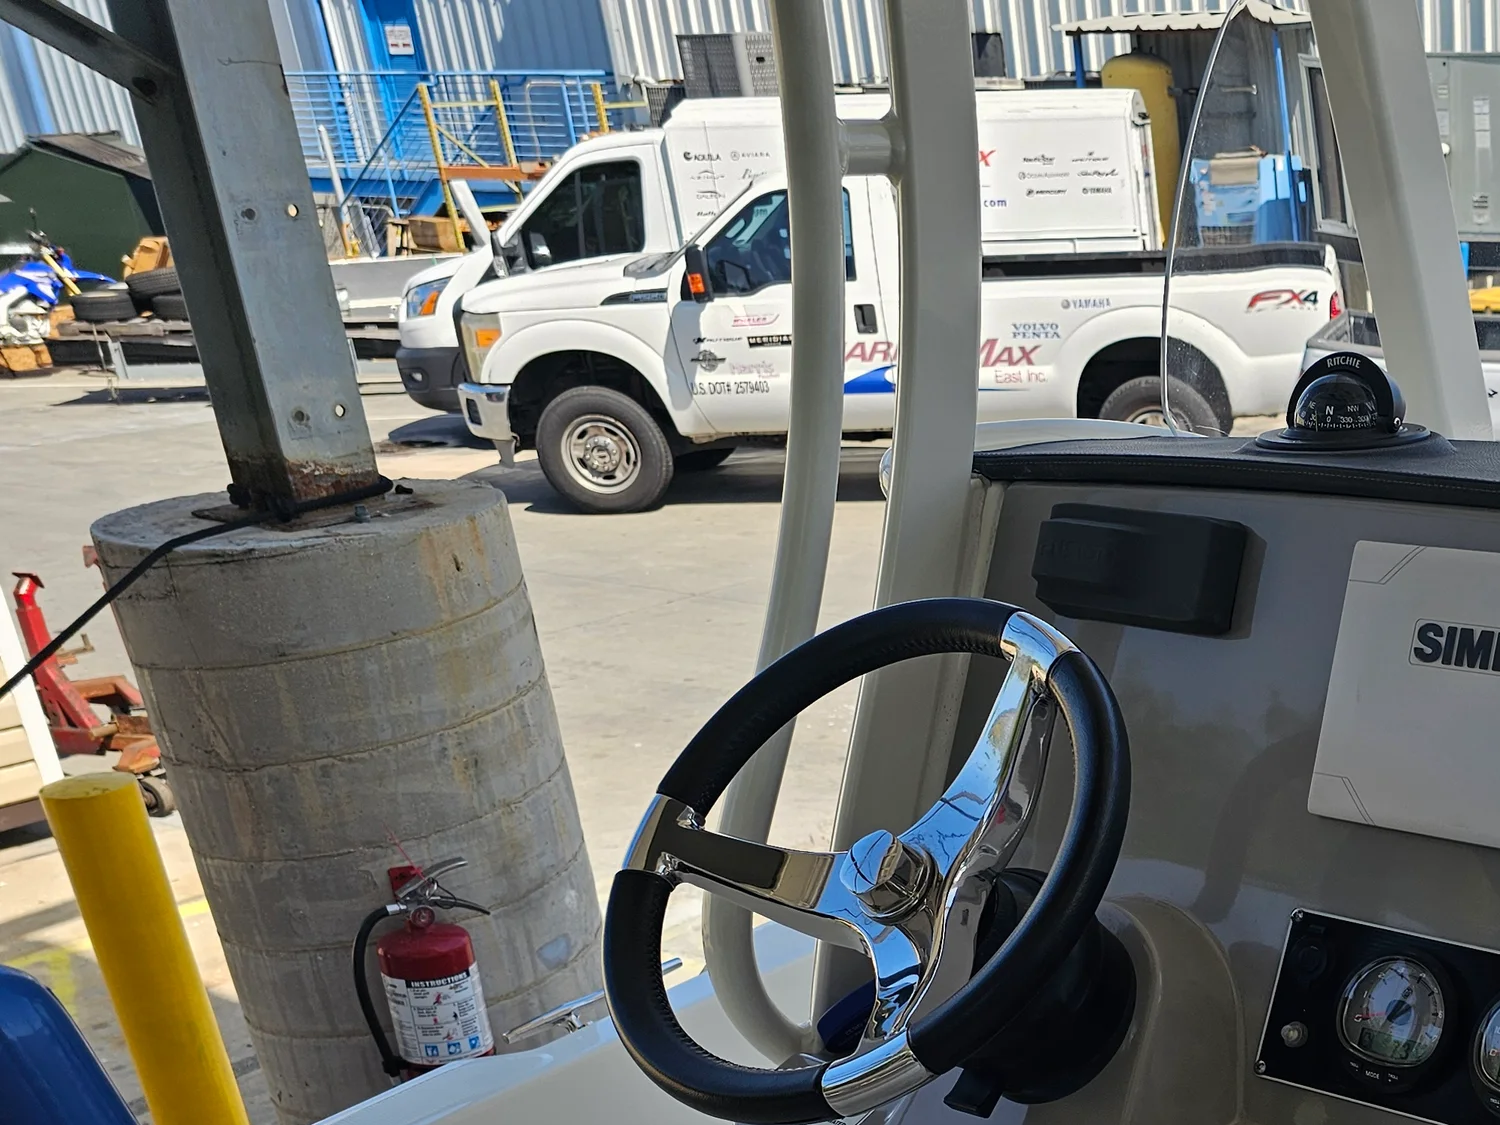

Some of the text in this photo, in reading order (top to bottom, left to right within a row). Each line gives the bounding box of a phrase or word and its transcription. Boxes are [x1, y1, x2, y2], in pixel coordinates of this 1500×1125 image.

[1071, 298, 1111, 309] YAMAHA
[1247, 289, 1318, 307] FX4
[1012, 323, 1059, 331] VOLVO
[1326, 356, 1361, 368] RITCHIE
[994, 369, 1048, 383] East Inc.
[735, 381, 770, 394] 2579403
[1325, 406, 1334, 415] N
[411, 972, 467, 988] INSTRUCTIONS
[1365, 1070, 1379, 1078] MODE
